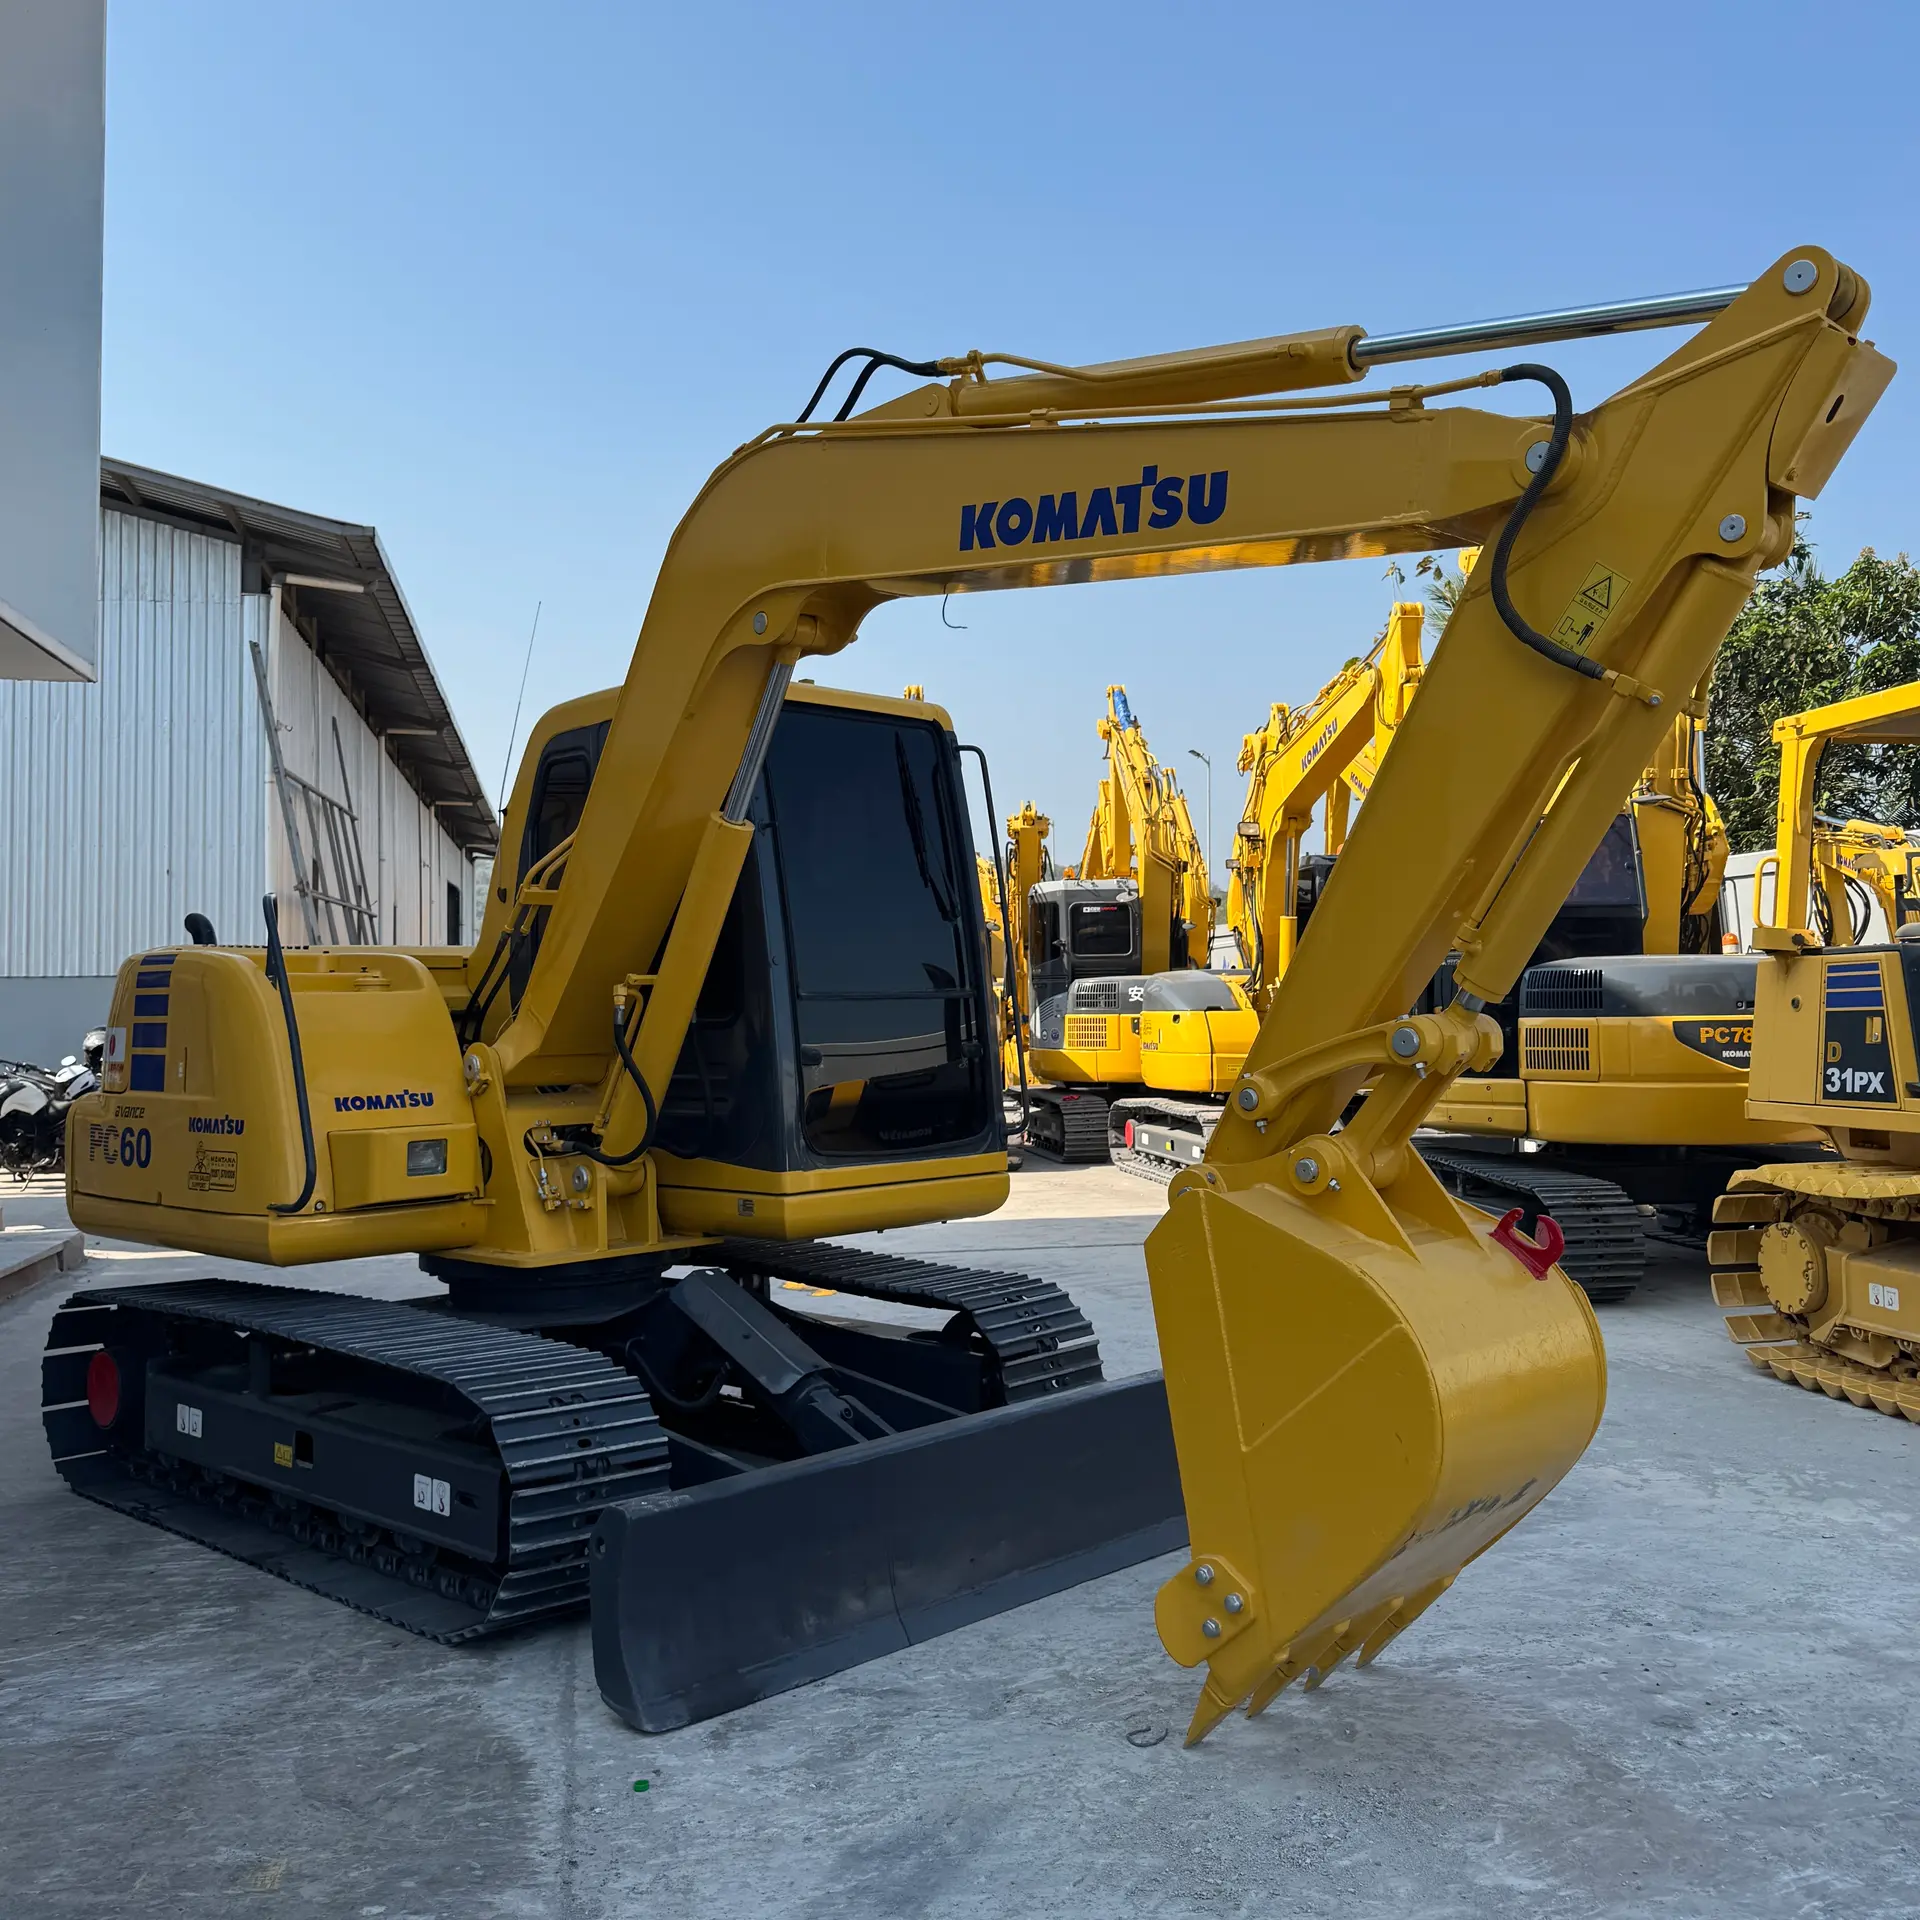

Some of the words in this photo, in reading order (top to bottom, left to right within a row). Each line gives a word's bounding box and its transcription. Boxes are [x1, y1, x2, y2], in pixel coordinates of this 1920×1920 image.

[959, 465, 1229, 551] KOMATSU
[1301, 716, 1338, 773] KOMATSU
[1128, 985, 1144, 1002] 安
[1700, 1026, 1753, 1044] PC78
[1827, 1041, 1843, 1063] D
[1825, 1067, 1885, 1094] 31PX
[114, 1105, 146, 1119] avance
[334, 1089, 434, 1113] KOMATSU
[188, 1114, 245, 1136] KOMATSU
[89, 1123, 152, 1169] PC60
